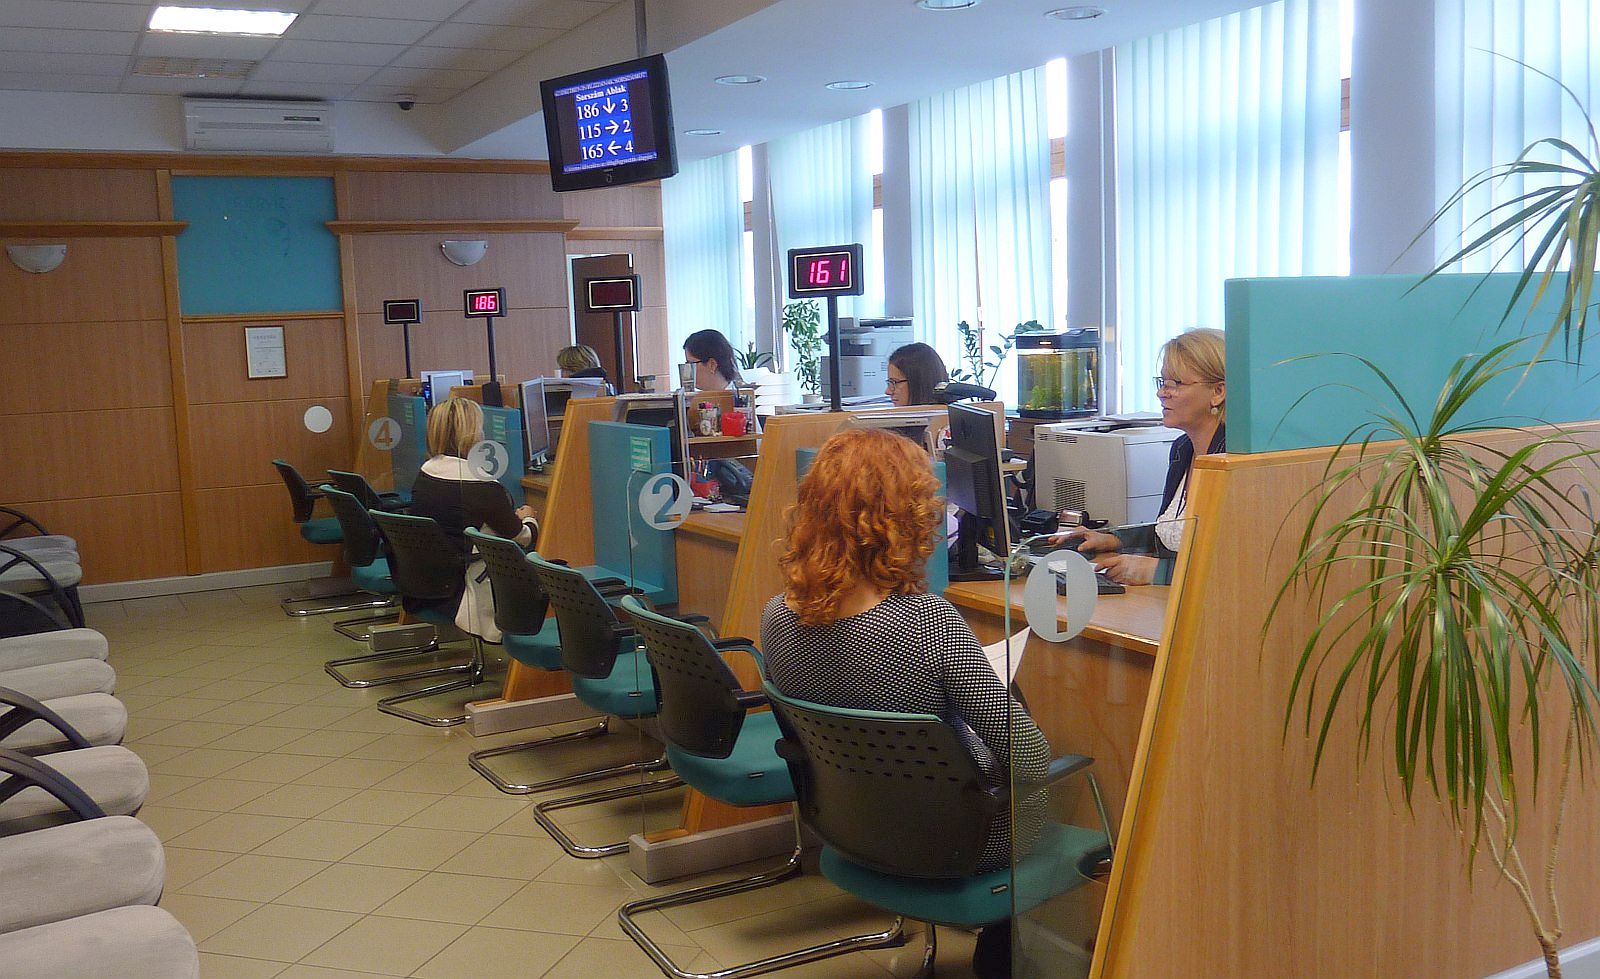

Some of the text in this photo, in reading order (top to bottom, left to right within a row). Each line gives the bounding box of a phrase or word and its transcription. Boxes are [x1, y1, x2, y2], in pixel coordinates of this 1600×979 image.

[576, 85, 626, 102] Sorszám Ablak
[577, 99, 629, 120] 186 3
[580, 120, 631, 140] 115 2
[582, 140, 634, 160] 165 4
[809, 259, 847, 284] 161
[475, 295, 496, 310] 186
[374, 420, 393, 447] 4
[477, 443, 499, 476] 3
[652, 477, 682, 524] 2
[1048, 560, 1068, 633] 1
